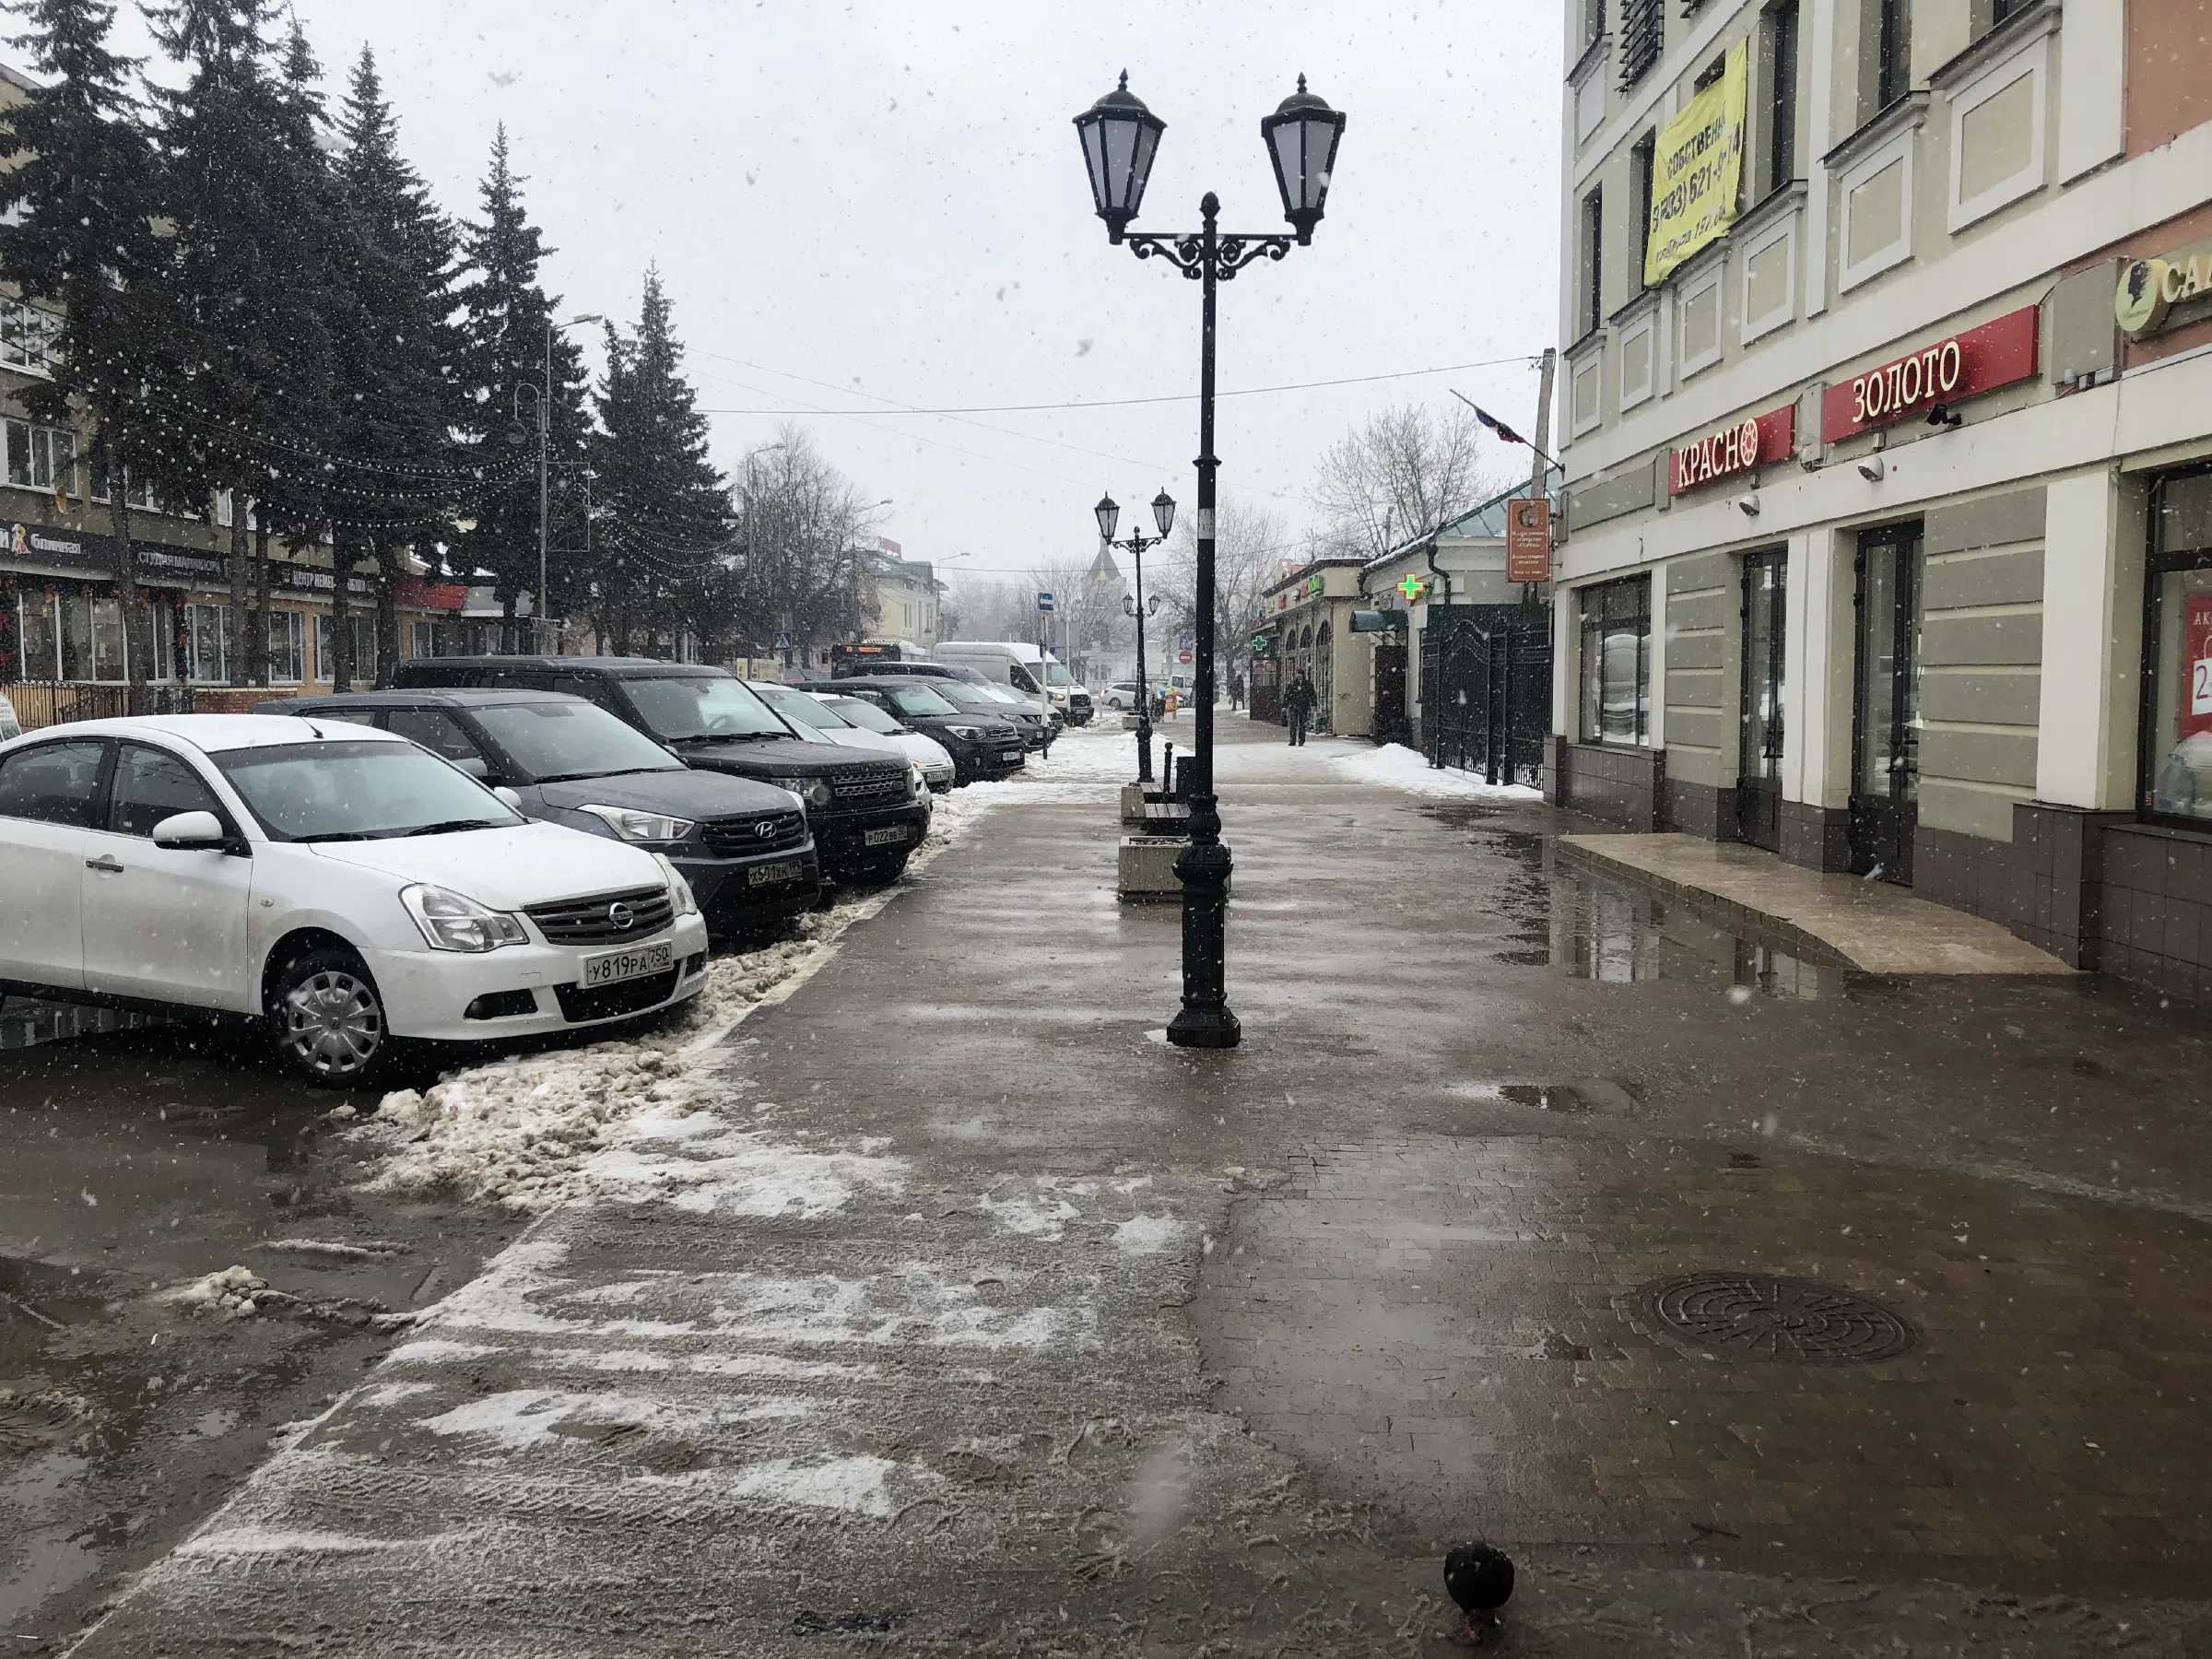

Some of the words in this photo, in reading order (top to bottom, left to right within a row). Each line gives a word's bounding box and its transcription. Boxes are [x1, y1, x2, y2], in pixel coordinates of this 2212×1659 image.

[1852, 340, 1960, 424] ЗОЛОТО
[138, 551, 174, 568] СТУДИЯ
[175, 556, 221, 572] МАНИКЮРА
[2194, 611, 2212, 626] АК
[592, 956, 648, 981] У819РА
[648, 947, 669, 964] 750
